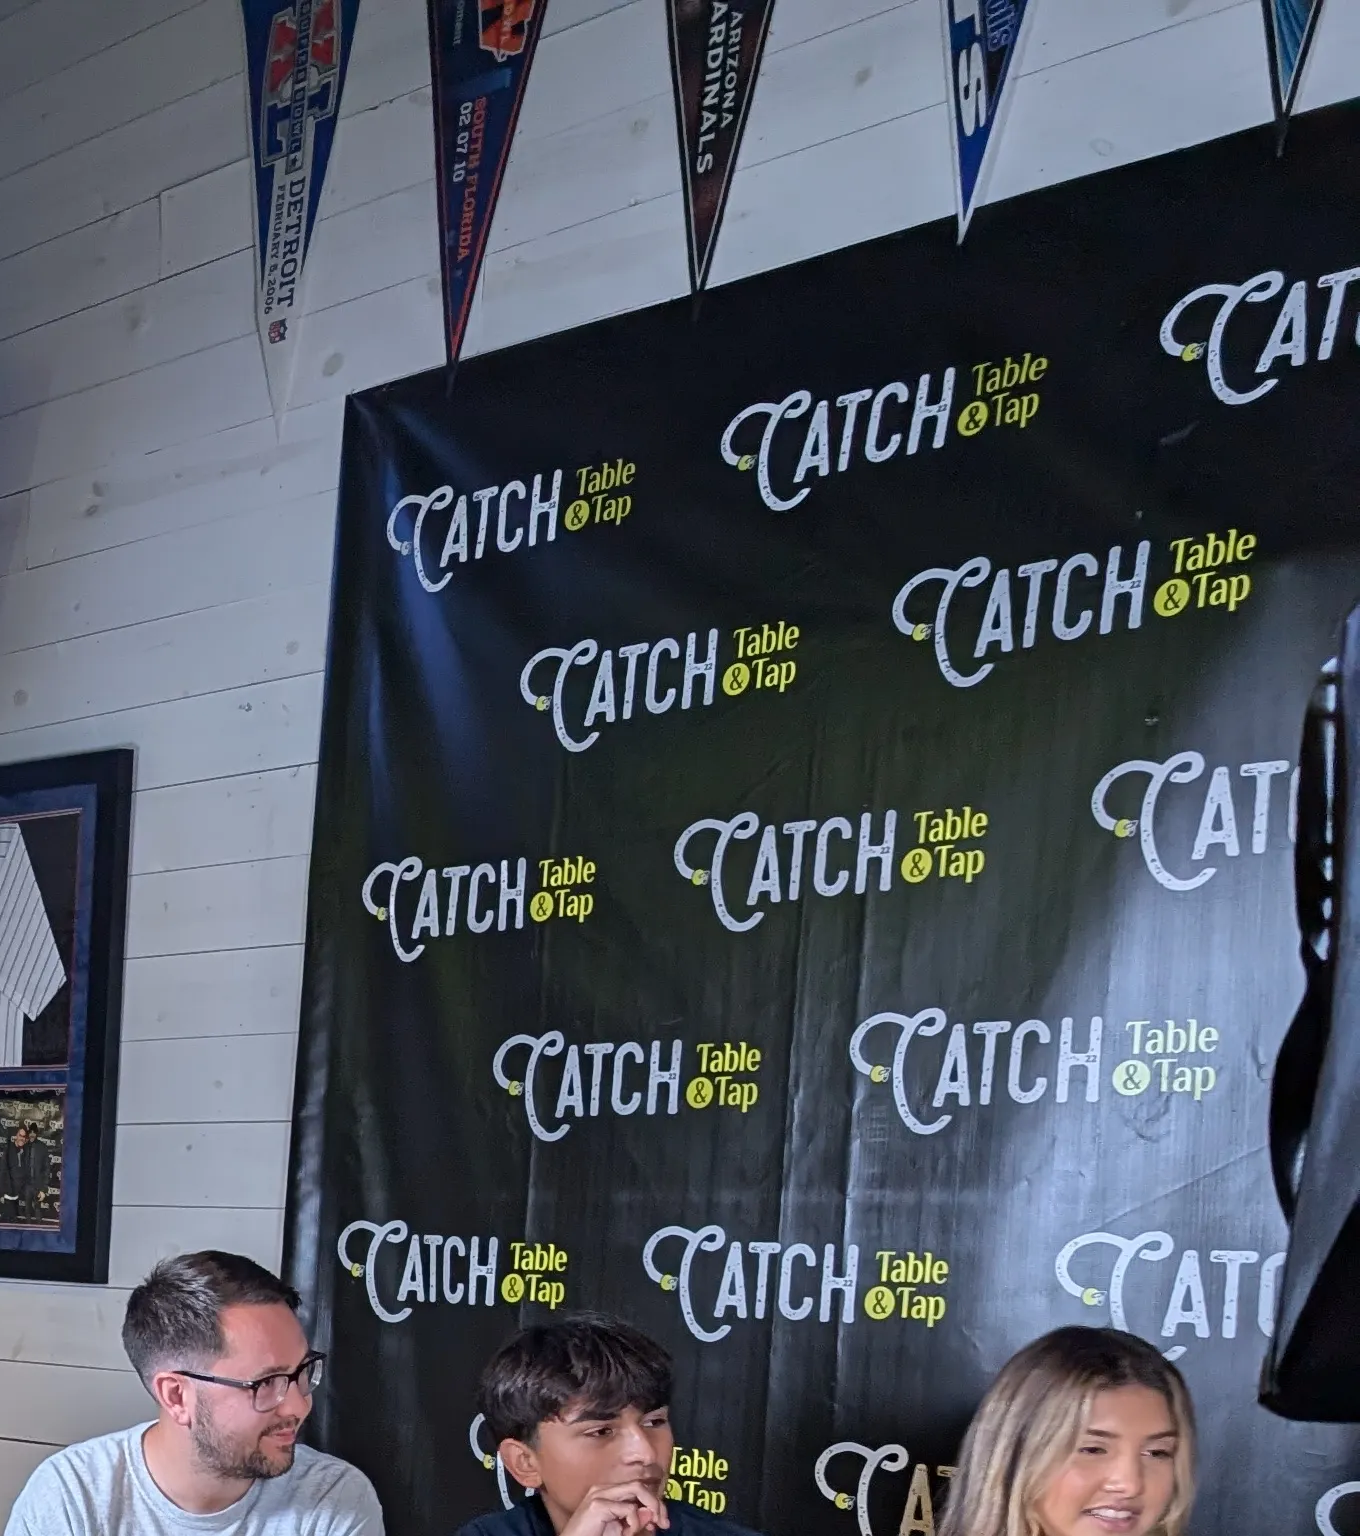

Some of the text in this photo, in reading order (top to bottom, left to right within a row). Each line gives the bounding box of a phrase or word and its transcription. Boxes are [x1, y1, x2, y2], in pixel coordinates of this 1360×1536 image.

[720, 12, 743, 128] ARIZONA
[457, 97, 487, 262] SOUTH FLORIDA
[269, 184, 286, 262] FEBRUARY
[278, 176, 306, 309] DETROIT
[1159, 268, 1360, 405] CAT
[972, 353, 1048, 397] Table
[990, 393, 1040, 429] Tap
[720, 367, 956, 512] CATCH
[576, 458, 636, 496] Table
[386, 469, 563, 593] CATCH
[591, 493, 632, 526] Tap
[1169, 529, 1257, 575] Table
[1190, 570, 1251, 613] Tap
[892, 540, 1151, 688] CATCH
[733, 621, 800, 659] Table
[519, 628, 719, 753] CATCH
[750, 655, 796, 693] Tap
[913, 806, 990, 846] Table
[1091, 750, 1299, 892] CAT
[538, 856, 596, 887] Table
[674, 808, 897, 933] CATCH
[932, 842, 986, 884] Tap
[362, 856, 527, 963] CATCH
[554, 888, 594, 923] Tap
[696, 1041, 761, 1074] Table
[1125, 1018, 1219, 1056] Table
[492, 1030, 682, 1143] CATCH
[849, 1007, 1103, 1135] CATCH
[1150, 1060, 1217, 1101] Tap
[713, 1074, 759, 1112] Tap
[337, 1219, 499, 1323] CATCH
[510, 1242, 568, 1271] Table
[875, 1250, 949, 1285] Table
[525, 1274, 565, 1310] Tap
[642, 1224, 859, 1343] CATCH
[895, 1286, 947, 1327] Tap
[682, 1480, 727, 1514] Tap
